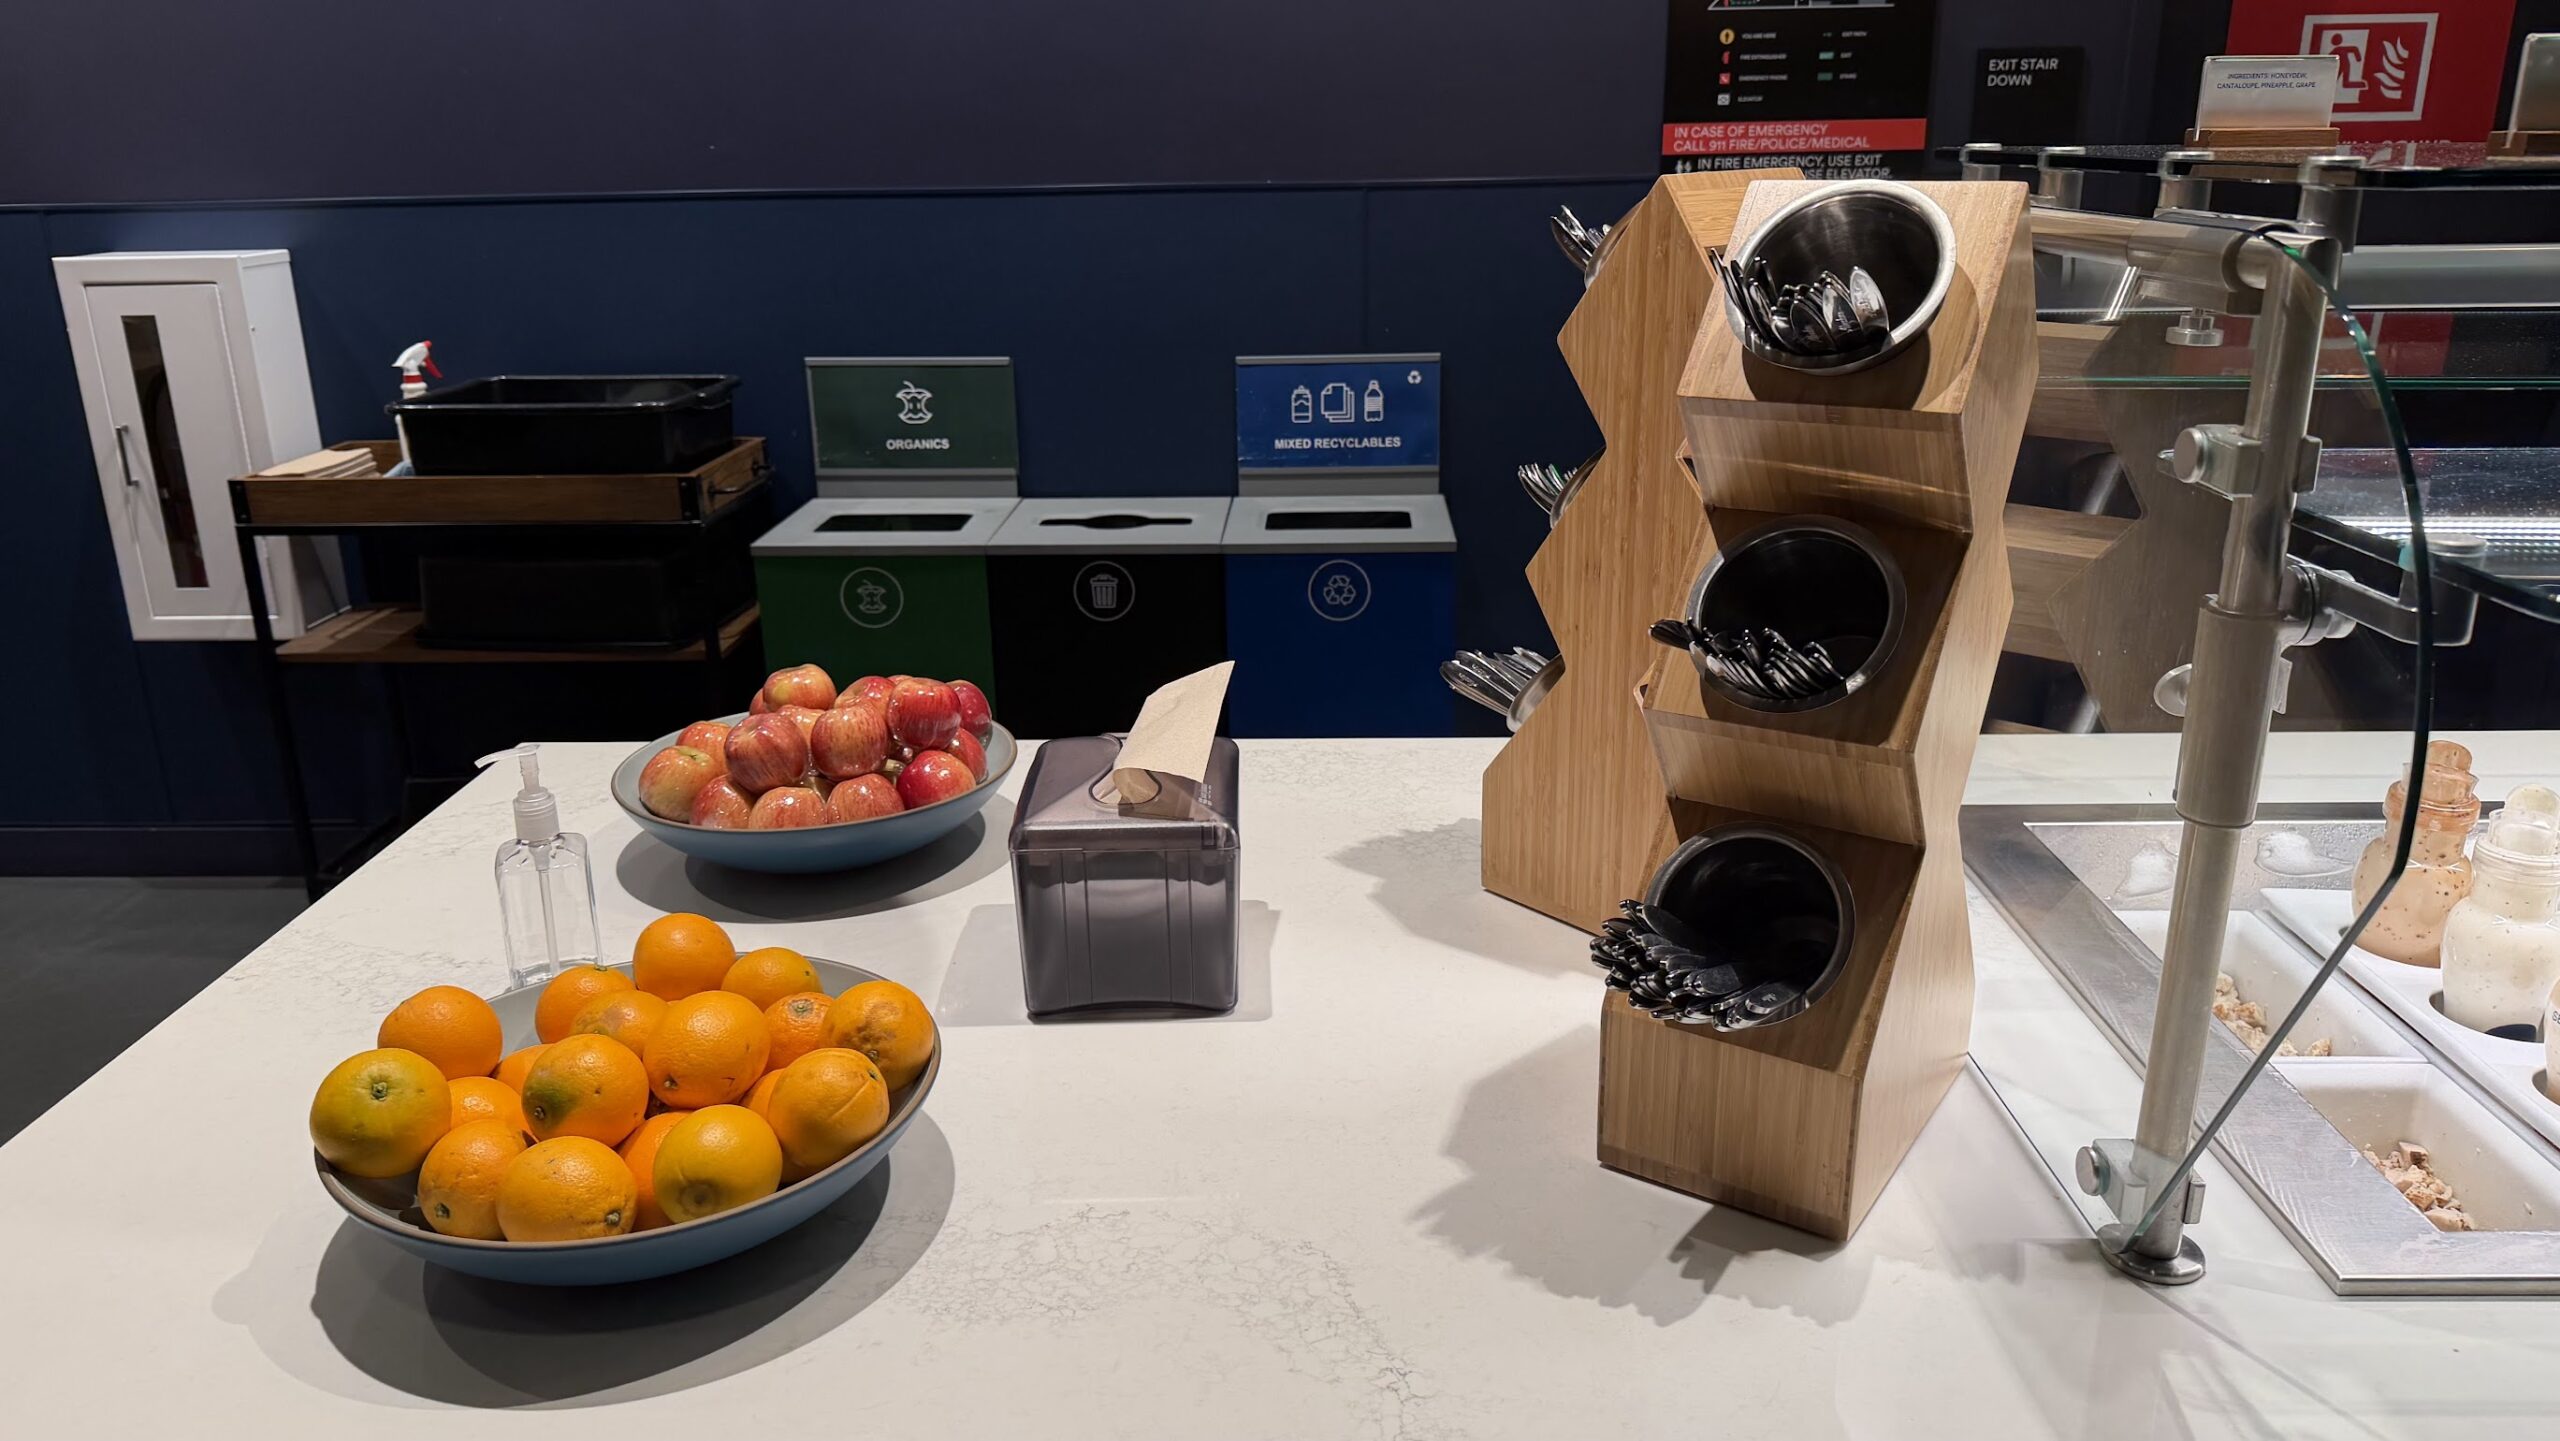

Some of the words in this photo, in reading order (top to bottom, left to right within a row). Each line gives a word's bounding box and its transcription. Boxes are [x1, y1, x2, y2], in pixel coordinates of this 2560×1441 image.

[1988, 58, 2019, 72] EXIT
[2020, 58, 2059, 71] STAIR
[1987, 74, 2033, 87] DOWN
[1674, 126, 1689, 139] IN
[1690, 126, 1724, 138] CASE
[1727, 125, 1746, 138] OF
[1748, 123, 1829, 137] EMERGENCY
[1673, 140, 1707, 153] CALL
[1708, 140, 1727, 152] 911
[1728, 136, 1870, 151] FIRE/POLICE/MEDICAL
[1697, 158, 1713, 170] IN
[1714, 157, 1741, 170] FIRE
[1743, 155, 1825, 169] EMERGENCY,
[1827, 154, 1852, 167] USE
[1854, 153, 1883, 166] EXIT
[885, 438, 951, 450] ORGANICS
[1274, 438, 1312, 450] MIXED
[1314, 436, 1402, 449] RECYCLABLES
